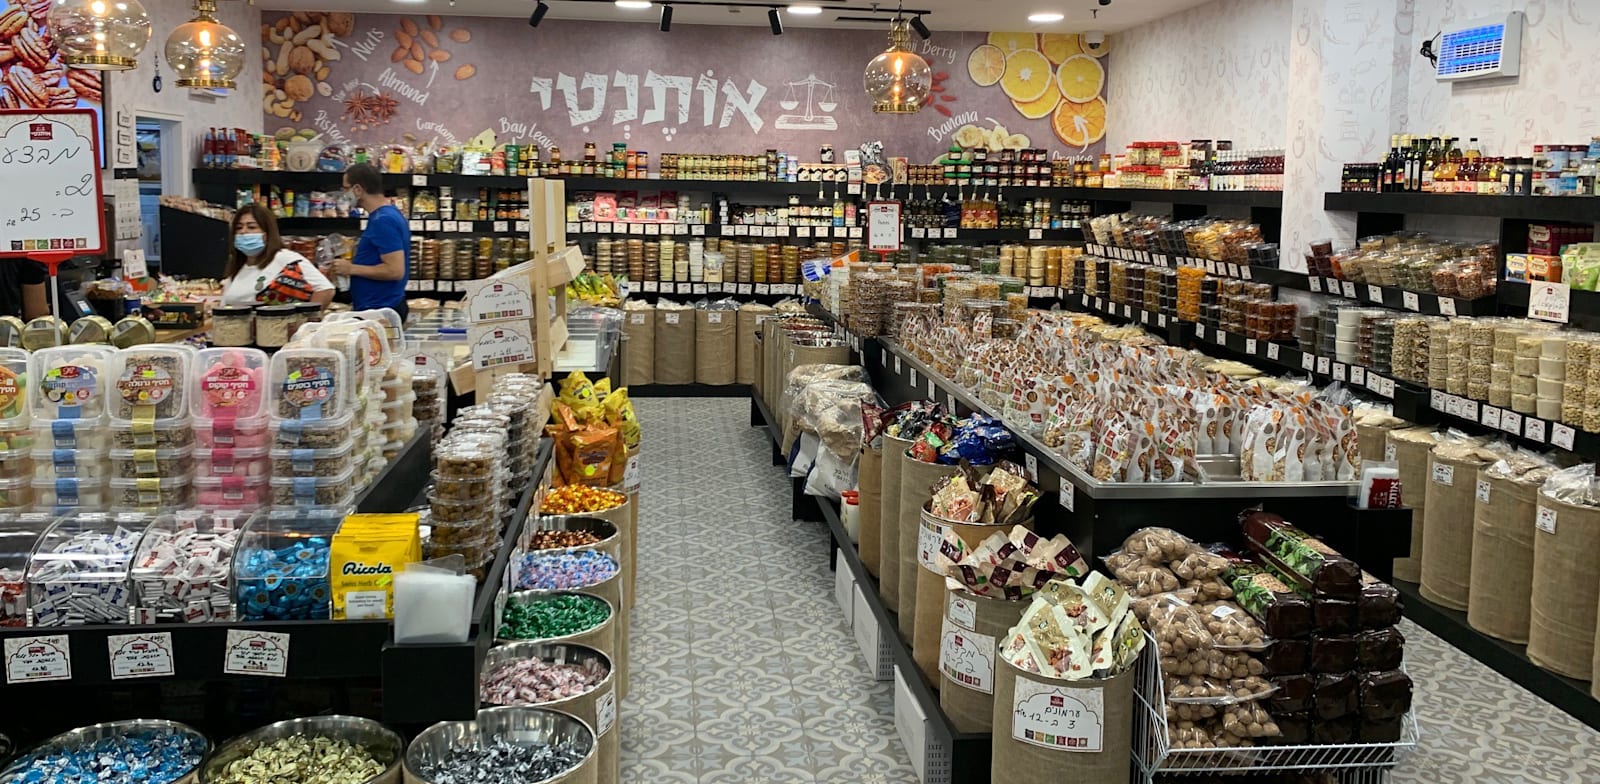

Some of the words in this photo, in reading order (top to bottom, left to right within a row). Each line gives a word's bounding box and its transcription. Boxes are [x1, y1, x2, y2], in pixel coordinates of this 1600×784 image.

[351, 27, 385, 62] Nuts
[922, 38, 957, 65] Berry
[378, 67, 430, 106] Almond
[499, 116, 527, 139] Bay
[927, 110, 979, 144] Banana
[64, 173, 93, 196] 2
[342, 561, 392, 575] Ricola
